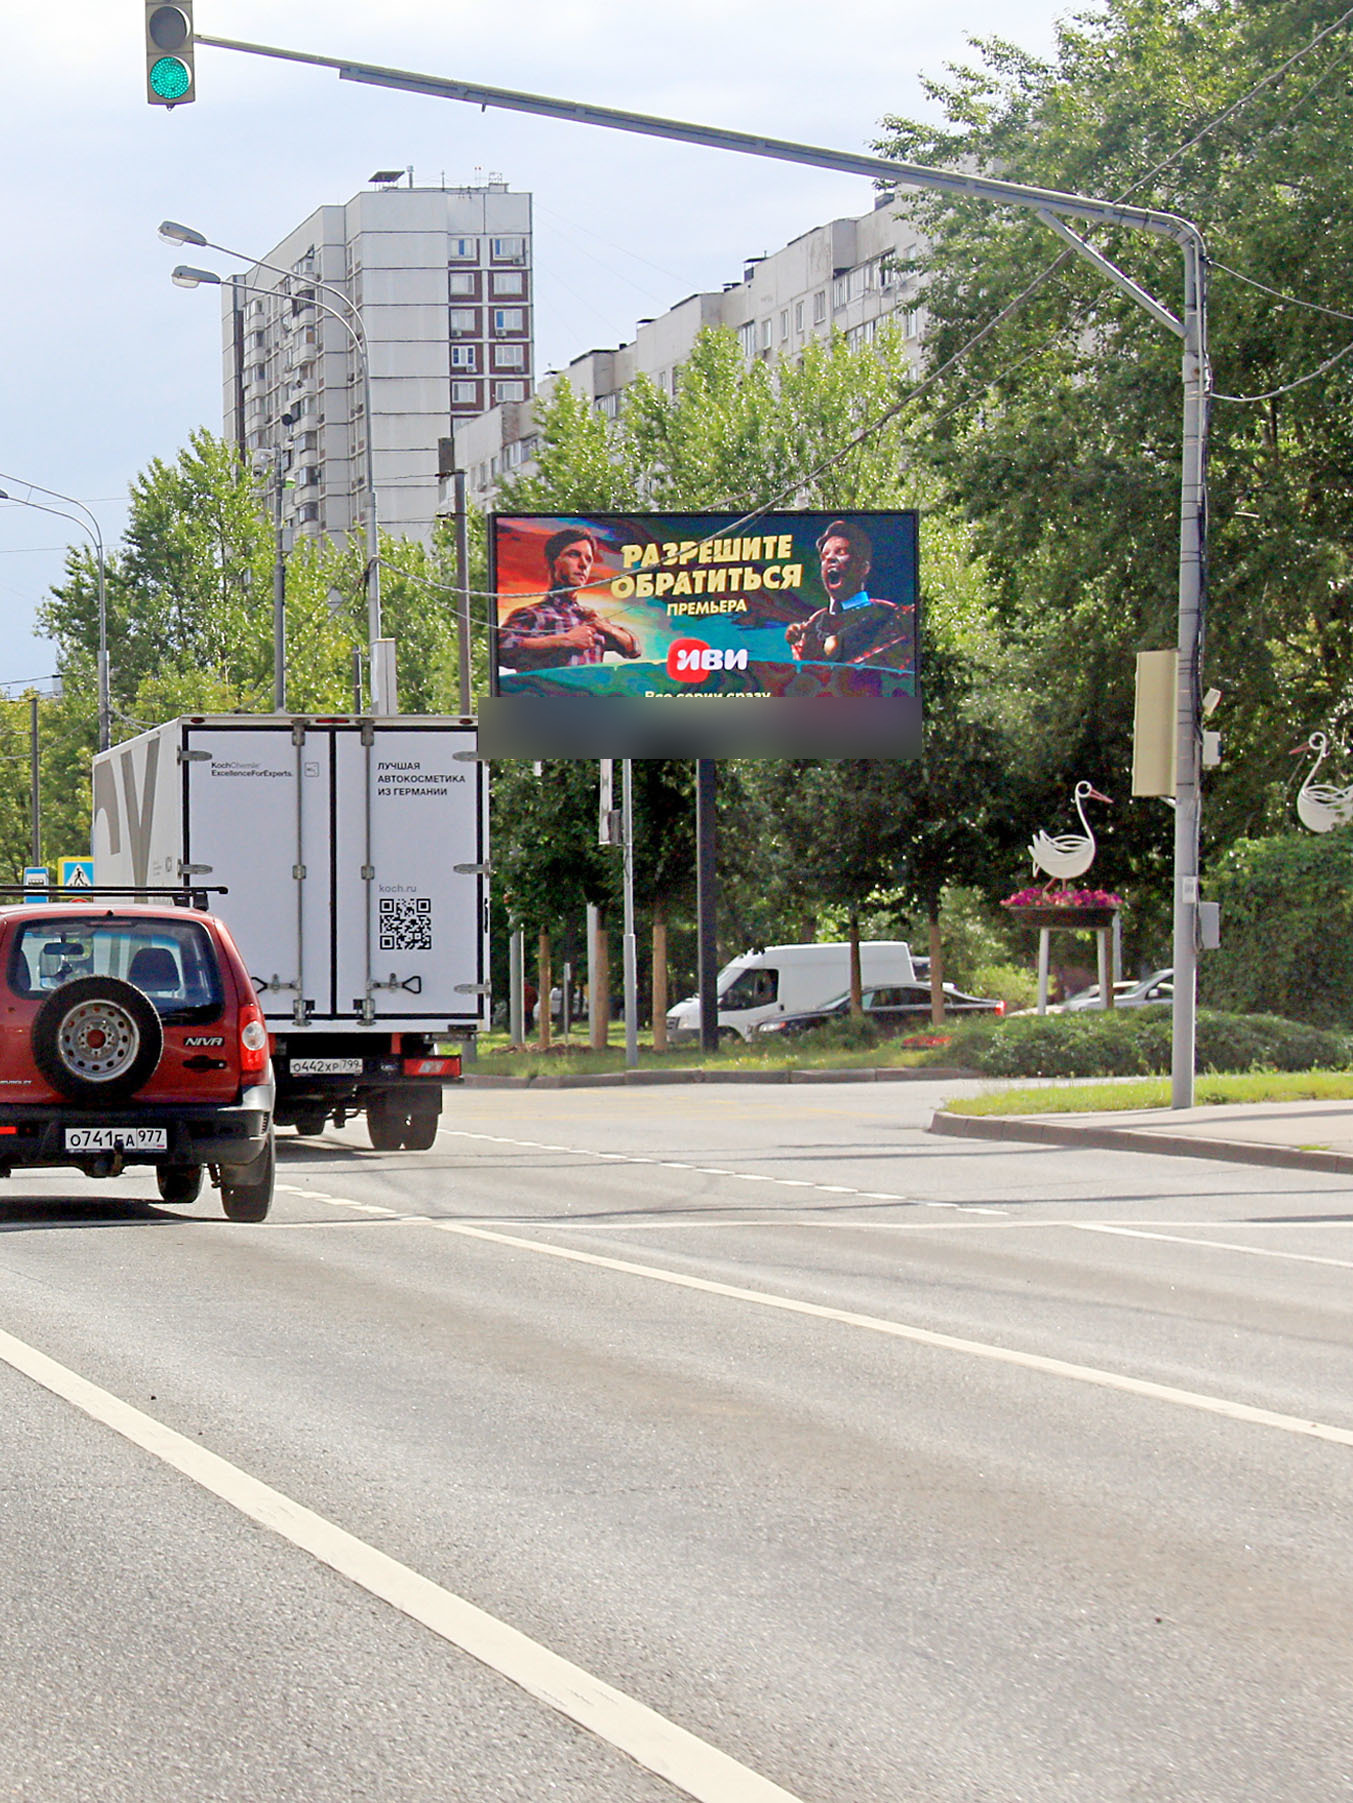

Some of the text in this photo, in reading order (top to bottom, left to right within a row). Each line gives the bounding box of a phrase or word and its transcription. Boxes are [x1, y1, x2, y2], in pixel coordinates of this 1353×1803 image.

[621, 534, 793, 568] РАЗРЕШИТЕ
[611, 563, 803, 599] ОБРАТИТЬСЯ
[666, 599, 747, 616] ПРЕМЬЕРА
[378, 762, 420, 770] ЛУЧШАЯ
[378, 775, 466, 783] АВТОКОСМЕТИКА
[378, 788, 447, 796] ИЗ ГЕРМАНИИ
[379, 884, 417, 893] koch.ru
[185, 1037, 223, 1046] NIVA
